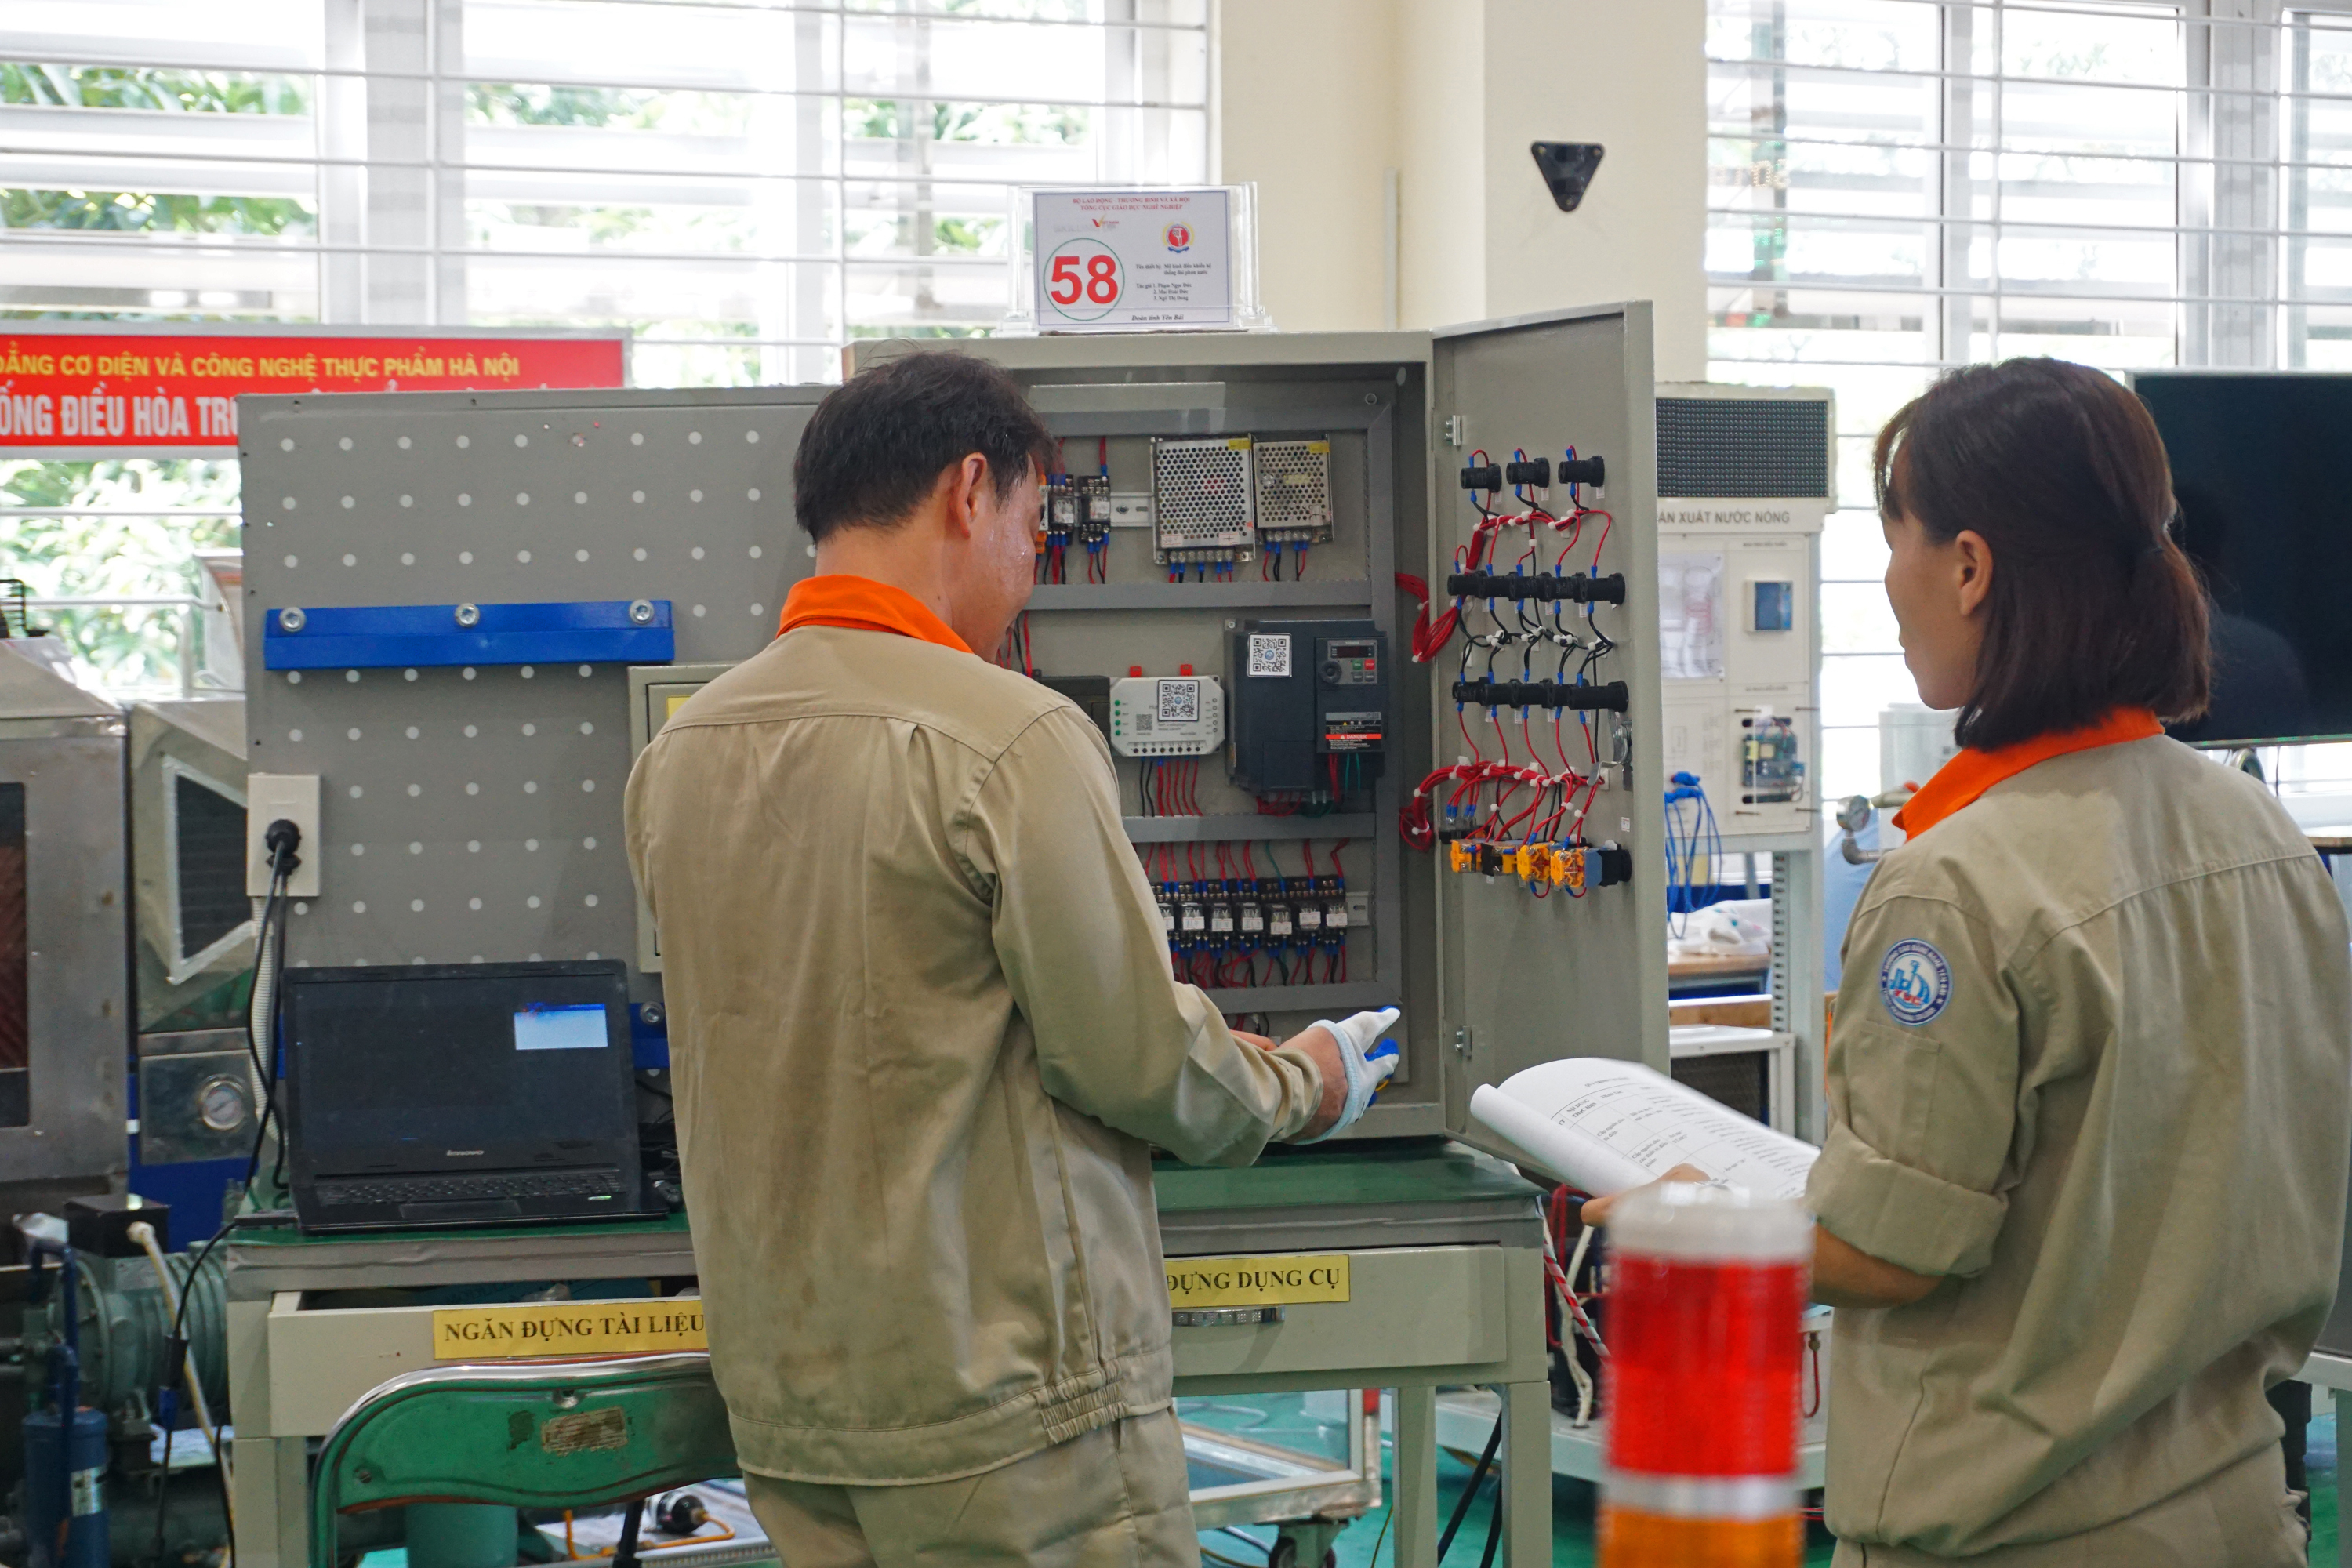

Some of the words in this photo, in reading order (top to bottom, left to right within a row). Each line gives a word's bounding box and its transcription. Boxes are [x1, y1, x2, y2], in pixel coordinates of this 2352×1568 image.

[1051, 254, 1119, 305] 58
[98, 350, 149, 382] ĐIỆN
[154, 351, 187, 376] VÀ
[191, 351, 254, 376] CÔNG
[260, 352, 318, 383] NGHỆ
[321, 355, 379, 383] THỰC
[384, 346, 445, 376] PHẨM
[449, 353, 478, 376] HÀ
[483, 352, 520, 383] NỘI
[60, 380, 125, 437] ĐIỀU
[132, 386, 191, 437] HÒA
[1166, 1271, 1231, 1295] ĐỰNG
[1236, 1269, 1303, 1292] DỤNG
[1308, 1268, 1341, 1290] CỤ
[444, 1316, 514, 1341] NGĂN
[521, 1316, 593, 1341] ĐỰNG
[599, 1312, 641, 1336] TÀI
[648, 1312, 705, 1338] LIỆU
